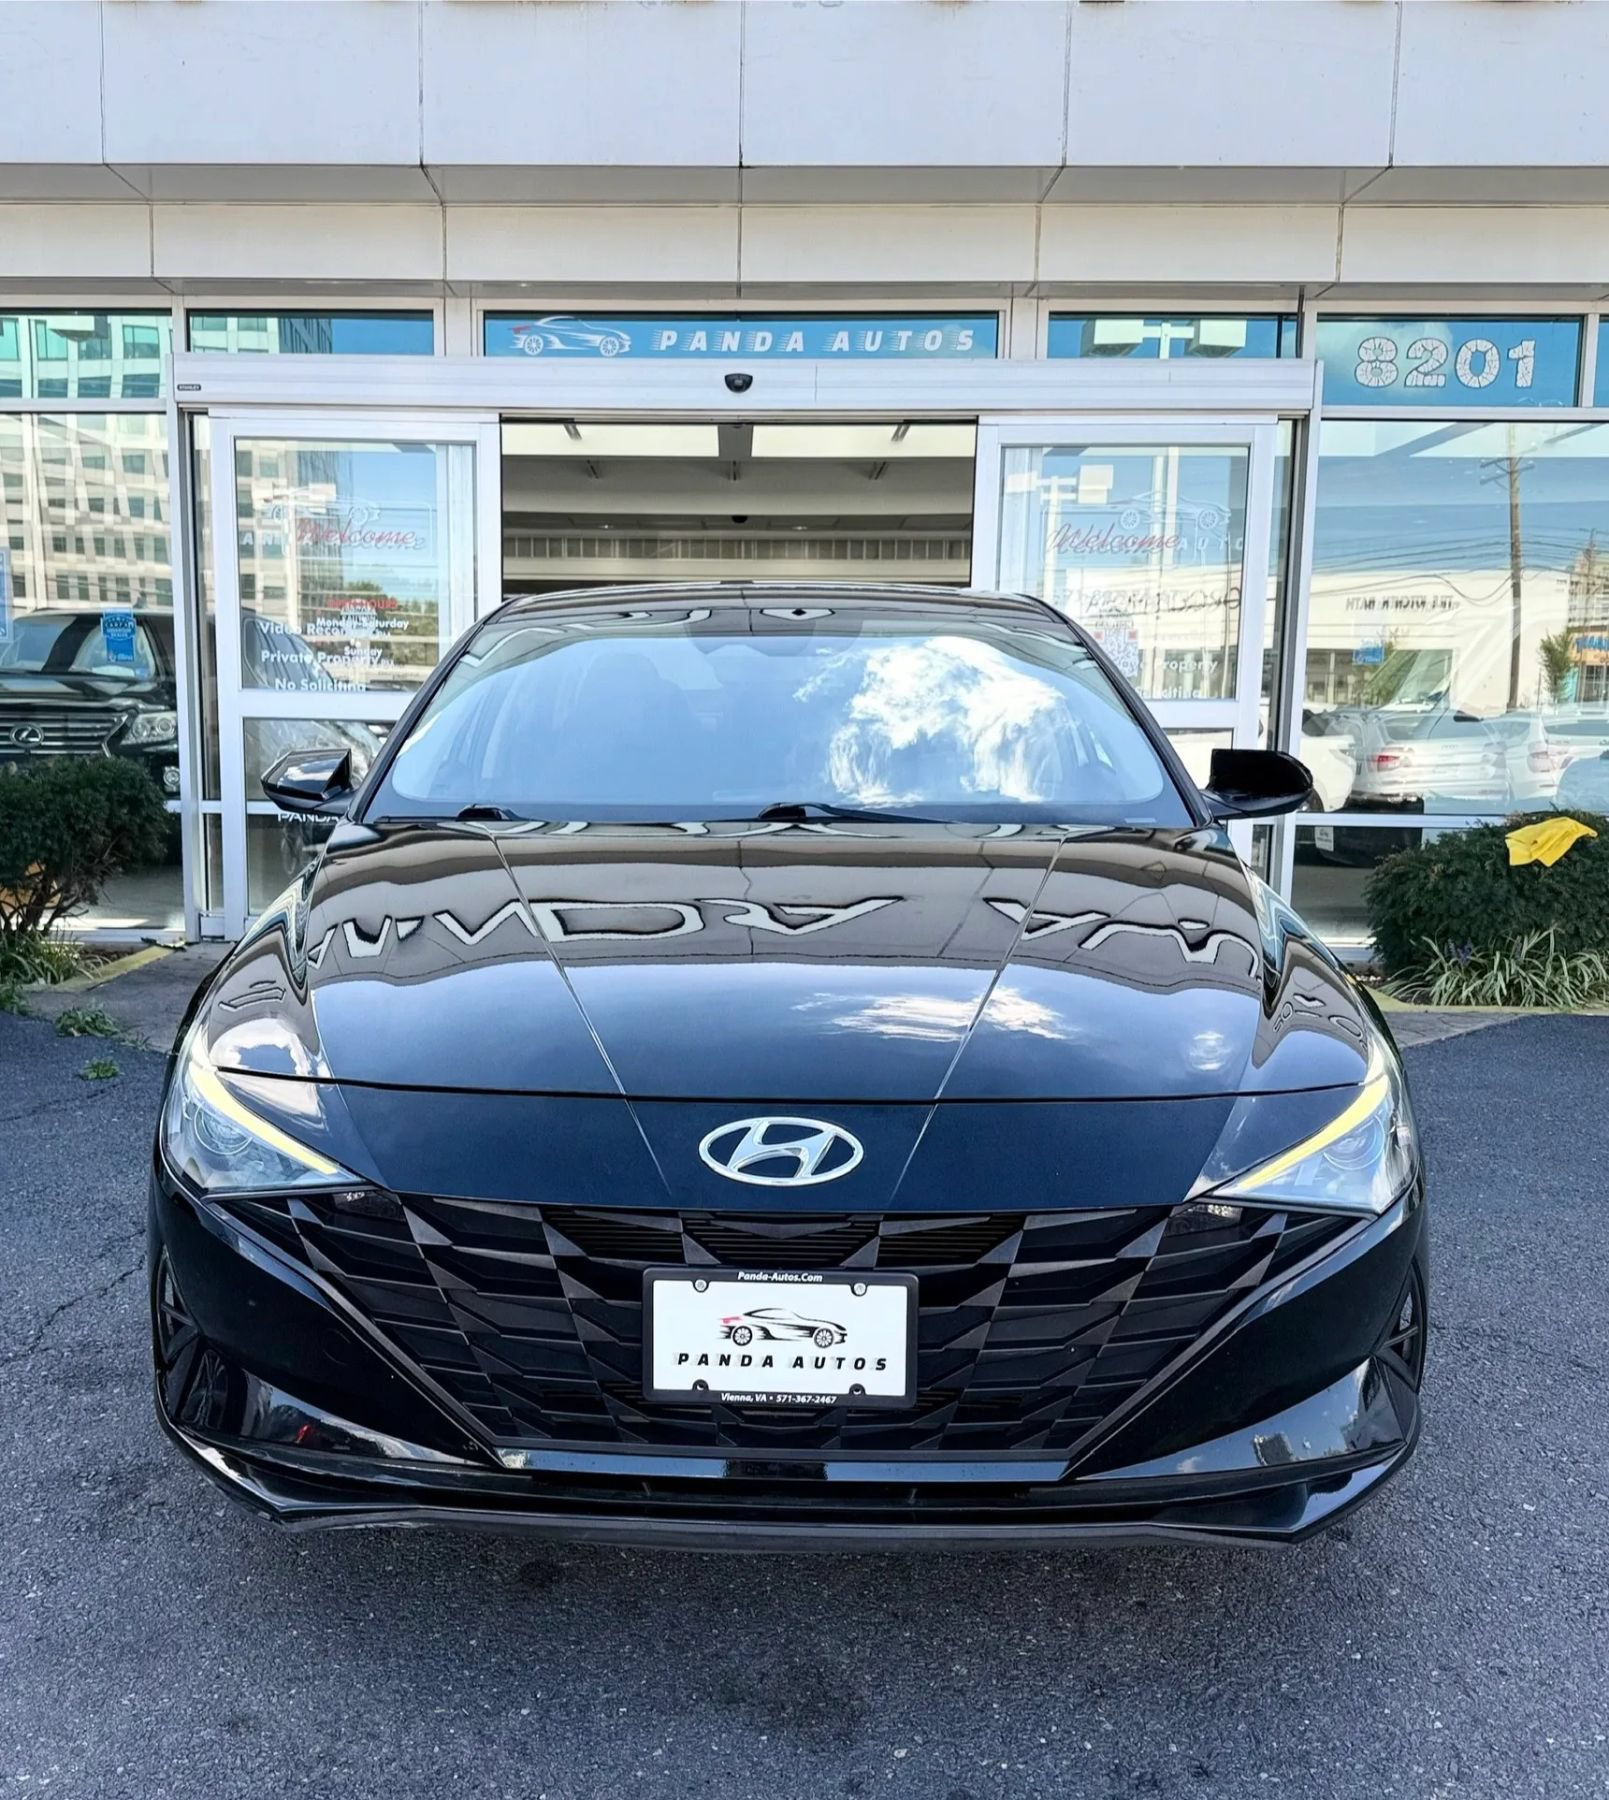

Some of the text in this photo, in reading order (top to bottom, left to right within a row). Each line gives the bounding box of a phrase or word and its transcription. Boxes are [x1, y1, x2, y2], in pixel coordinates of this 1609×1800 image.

[652, 329, 976, 353] PANDA AUTOS
[1353, 336, 1537, 389] 8201
[1047, 522, 1181, 552] Welcome
[261, 650, 313, 663] Private
[274, 677, 297, 691] No
[737, 1271, 823, 1283] Panda-Autos.Com
[675, 1352, 887, 1372] PANDA AUTOS
[720, 1392, 838, 1405] Vienna, VA 571-367-2467
